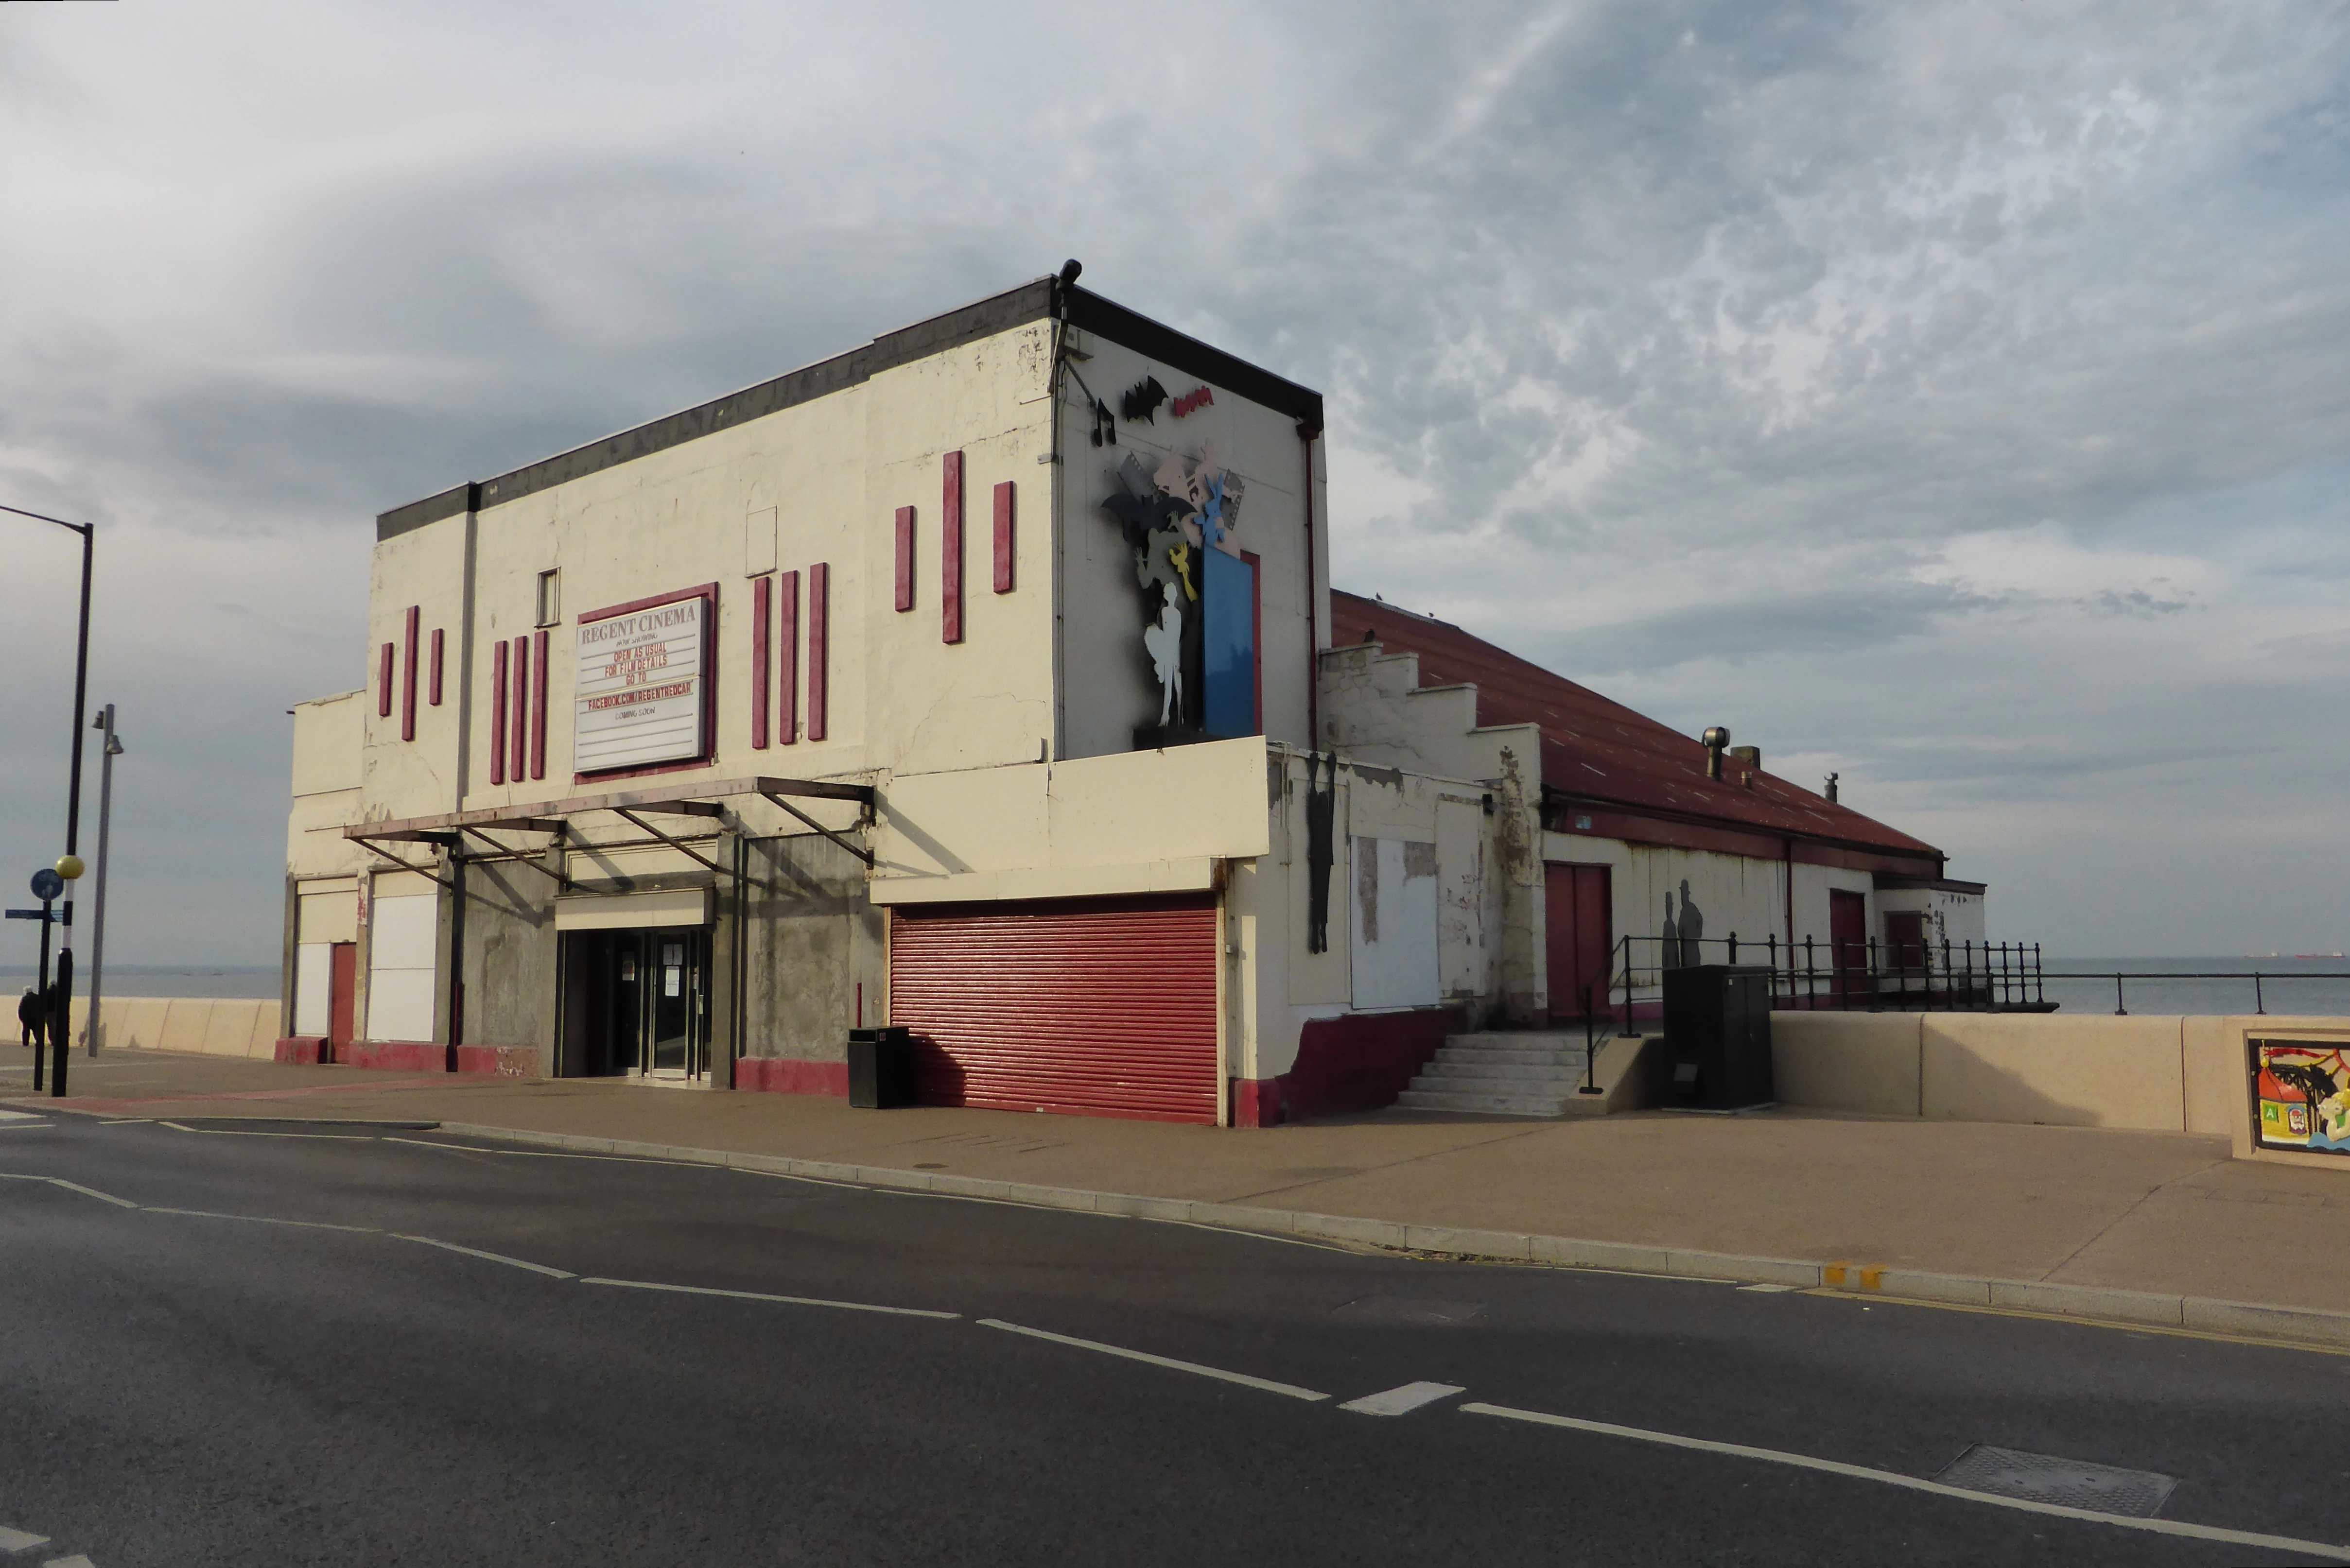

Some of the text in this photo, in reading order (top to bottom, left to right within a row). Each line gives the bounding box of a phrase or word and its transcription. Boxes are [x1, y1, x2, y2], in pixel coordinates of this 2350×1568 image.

[582, 605, 696, 645] REGENT CINEMA
[616, 632, 658, 647] NOW SHOWING
[614, 642, 666, 662] OPEN AS USUAL
[605, 655, 667, 677] FOR FILM DETAILS
[626, 671, 646, 686] GO TO
[588, 682, 691, 710] FACEBOOK.COM/REGENTREDCAR
[615, 706, 655, 720] COMING SOON
[2266, 1108, 2274, 1118] A
